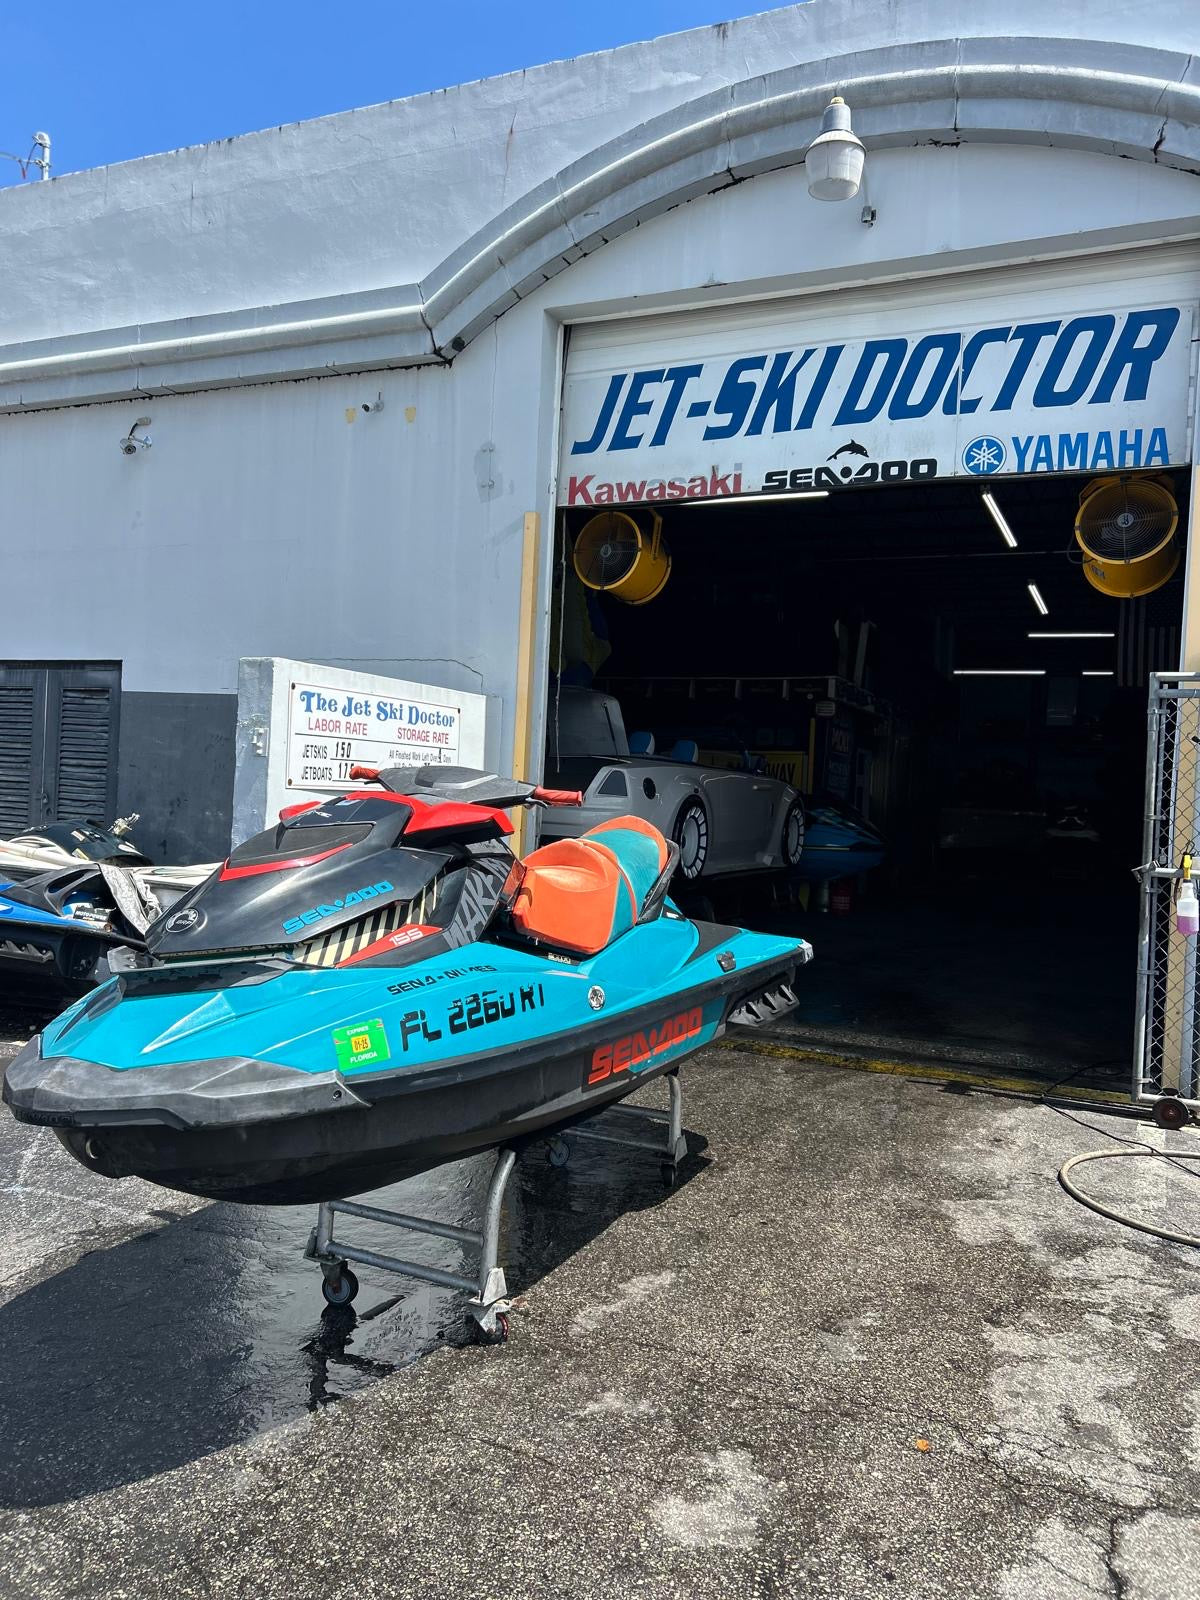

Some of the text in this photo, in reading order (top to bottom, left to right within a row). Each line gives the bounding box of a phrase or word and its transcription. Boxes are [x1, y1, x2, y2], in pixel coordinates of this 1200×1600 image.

[571, 307, 1181, 456] JET-SKI DOCTOR
[1012, 428, 1170, 473] YAMAHA
[567, 463, 743, 505] Kawasaki
[300, 691, 455, 727] The Jet Ski Doctor
[308, 717, 368, 736] LABOR RATE
[397, 728, 449, 744] STORAGE RATE
[302, 741, 352, 759] JETSKIS 150
[301, 766, 333, 781] JETBOATS
[389, 928, 424, 946] 155
[400, 1009, 442, 1051] FL
[350, 1050, 378, 1064] FLORIDA
